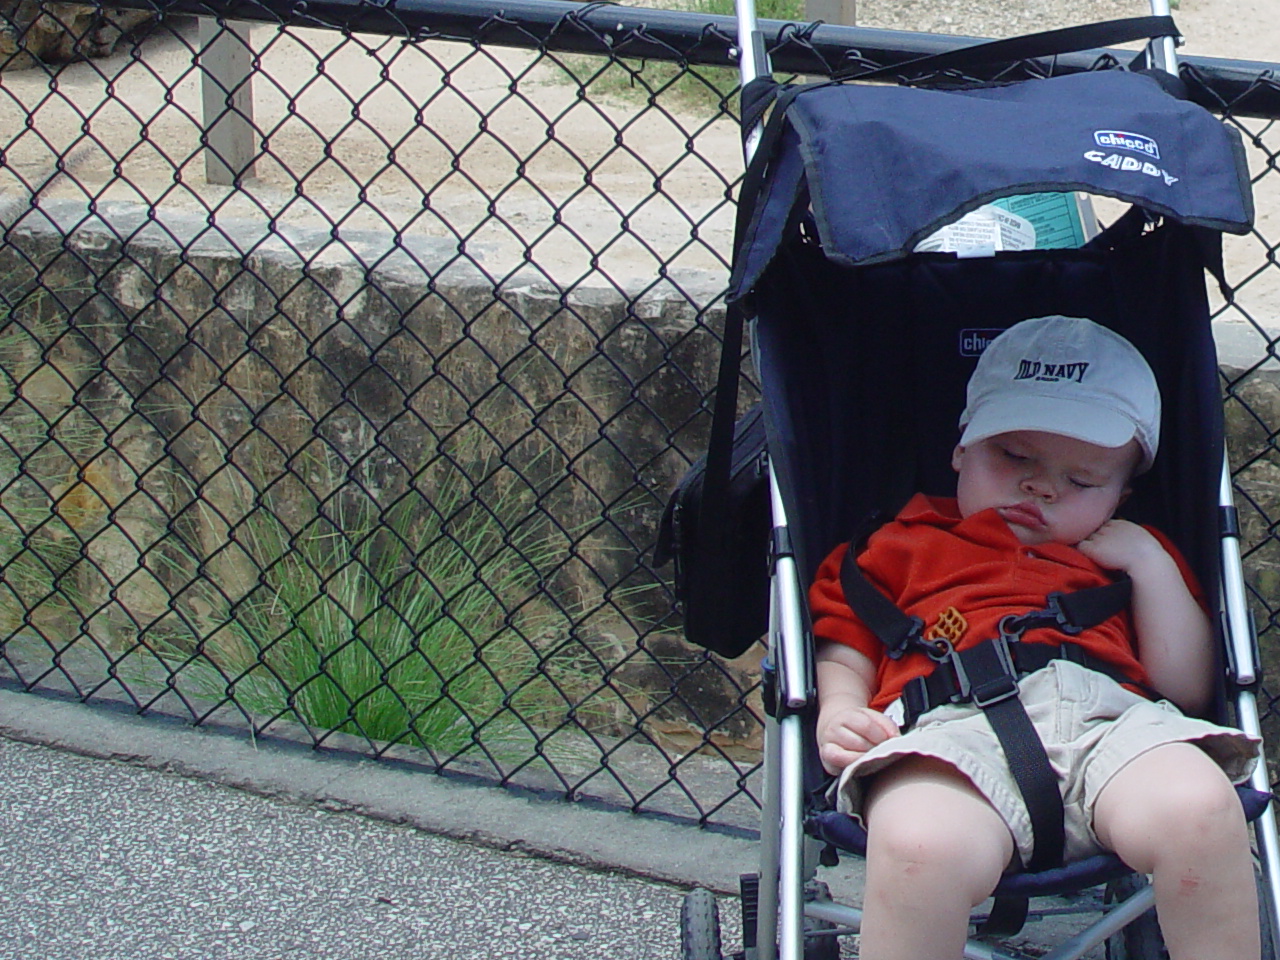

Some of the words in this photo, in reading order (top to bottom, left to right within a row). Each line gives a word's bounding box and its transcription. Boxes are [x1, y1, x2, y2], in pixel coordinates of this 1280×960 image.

[1083, 150, 1179, 187] CADDY
[1014, 359, 1042, 380] OLD
[1043, 362, 1090, 383] NAVY
